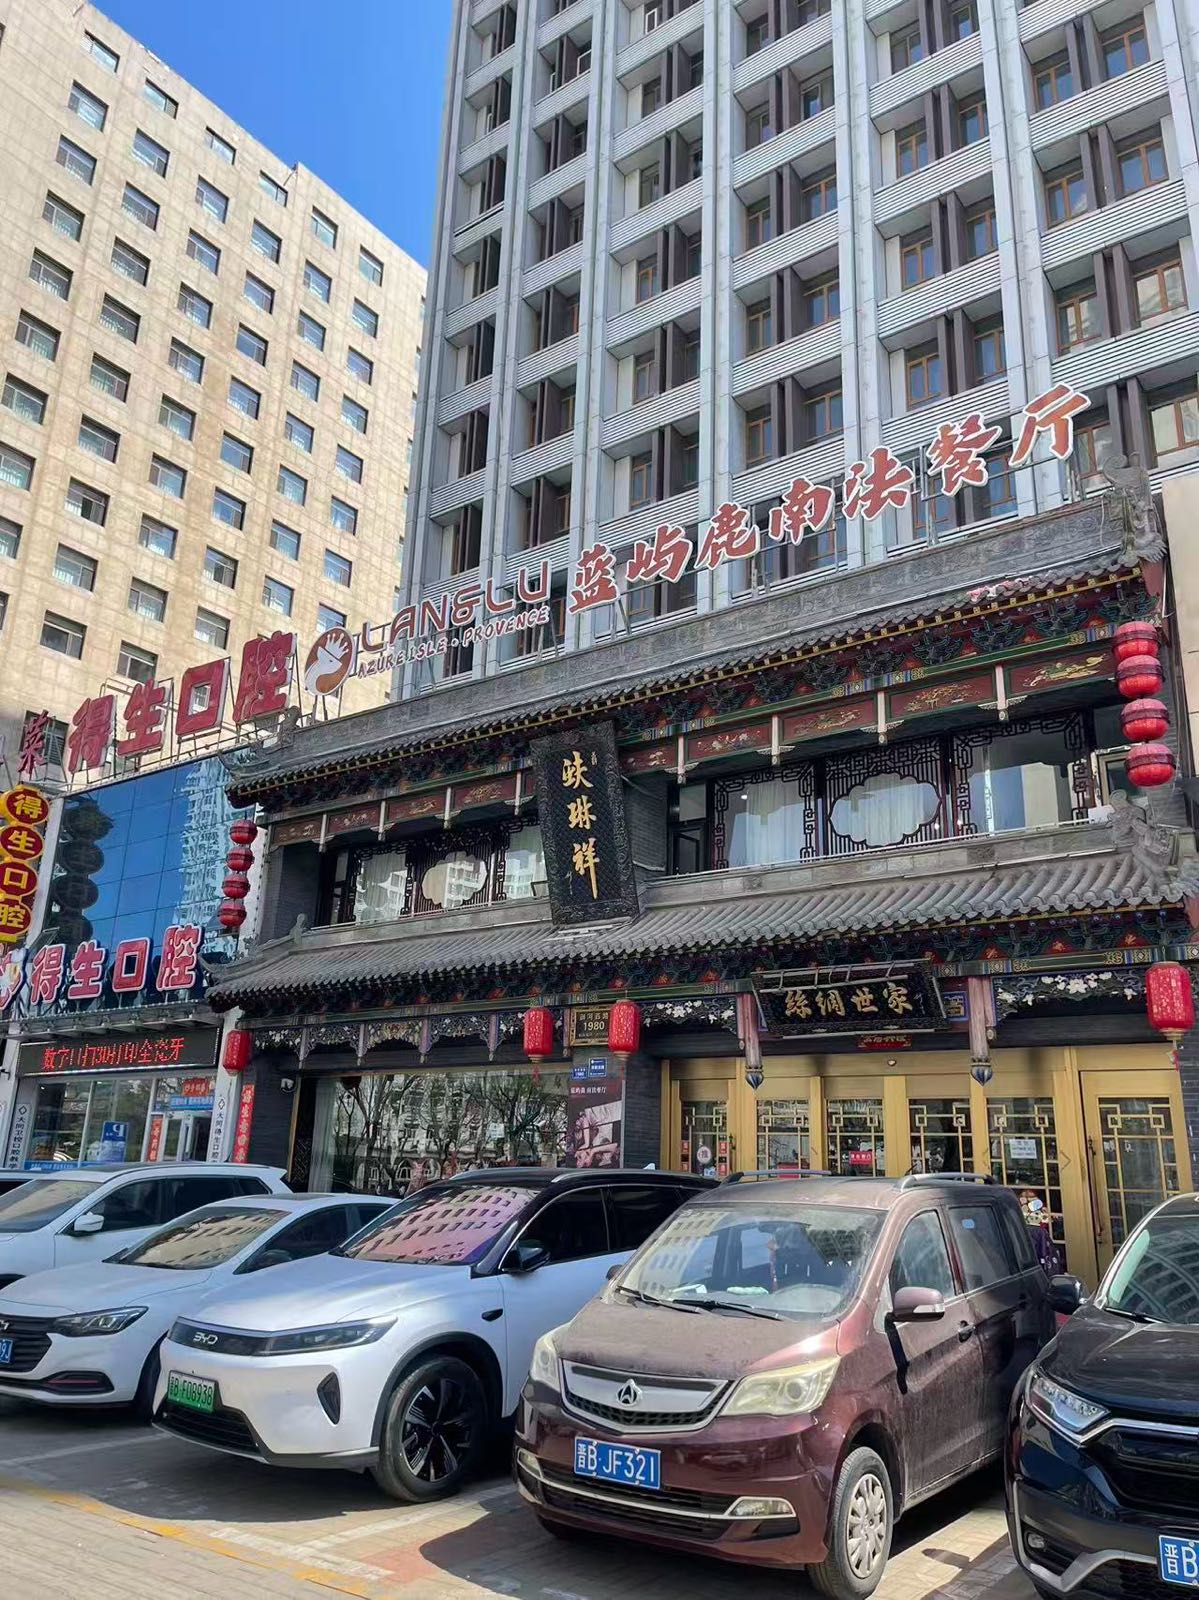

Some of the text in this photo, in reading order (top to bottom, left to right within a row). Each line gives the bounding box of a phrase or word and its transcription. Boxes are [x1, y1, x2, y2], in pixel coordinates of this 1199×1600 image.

[566, 383, 1092, 615] 蓝屿鹿南法餐厅
[358, 605, 551, 679] AZURE ISLE PROVENCE
[68, 630, 296, 774] 得生口腔
[0, 793, 43, 929] 得生口腔
[31, 923, 202, 1005] 得生口腔
[583, 1020, 605, 1031] 1980
